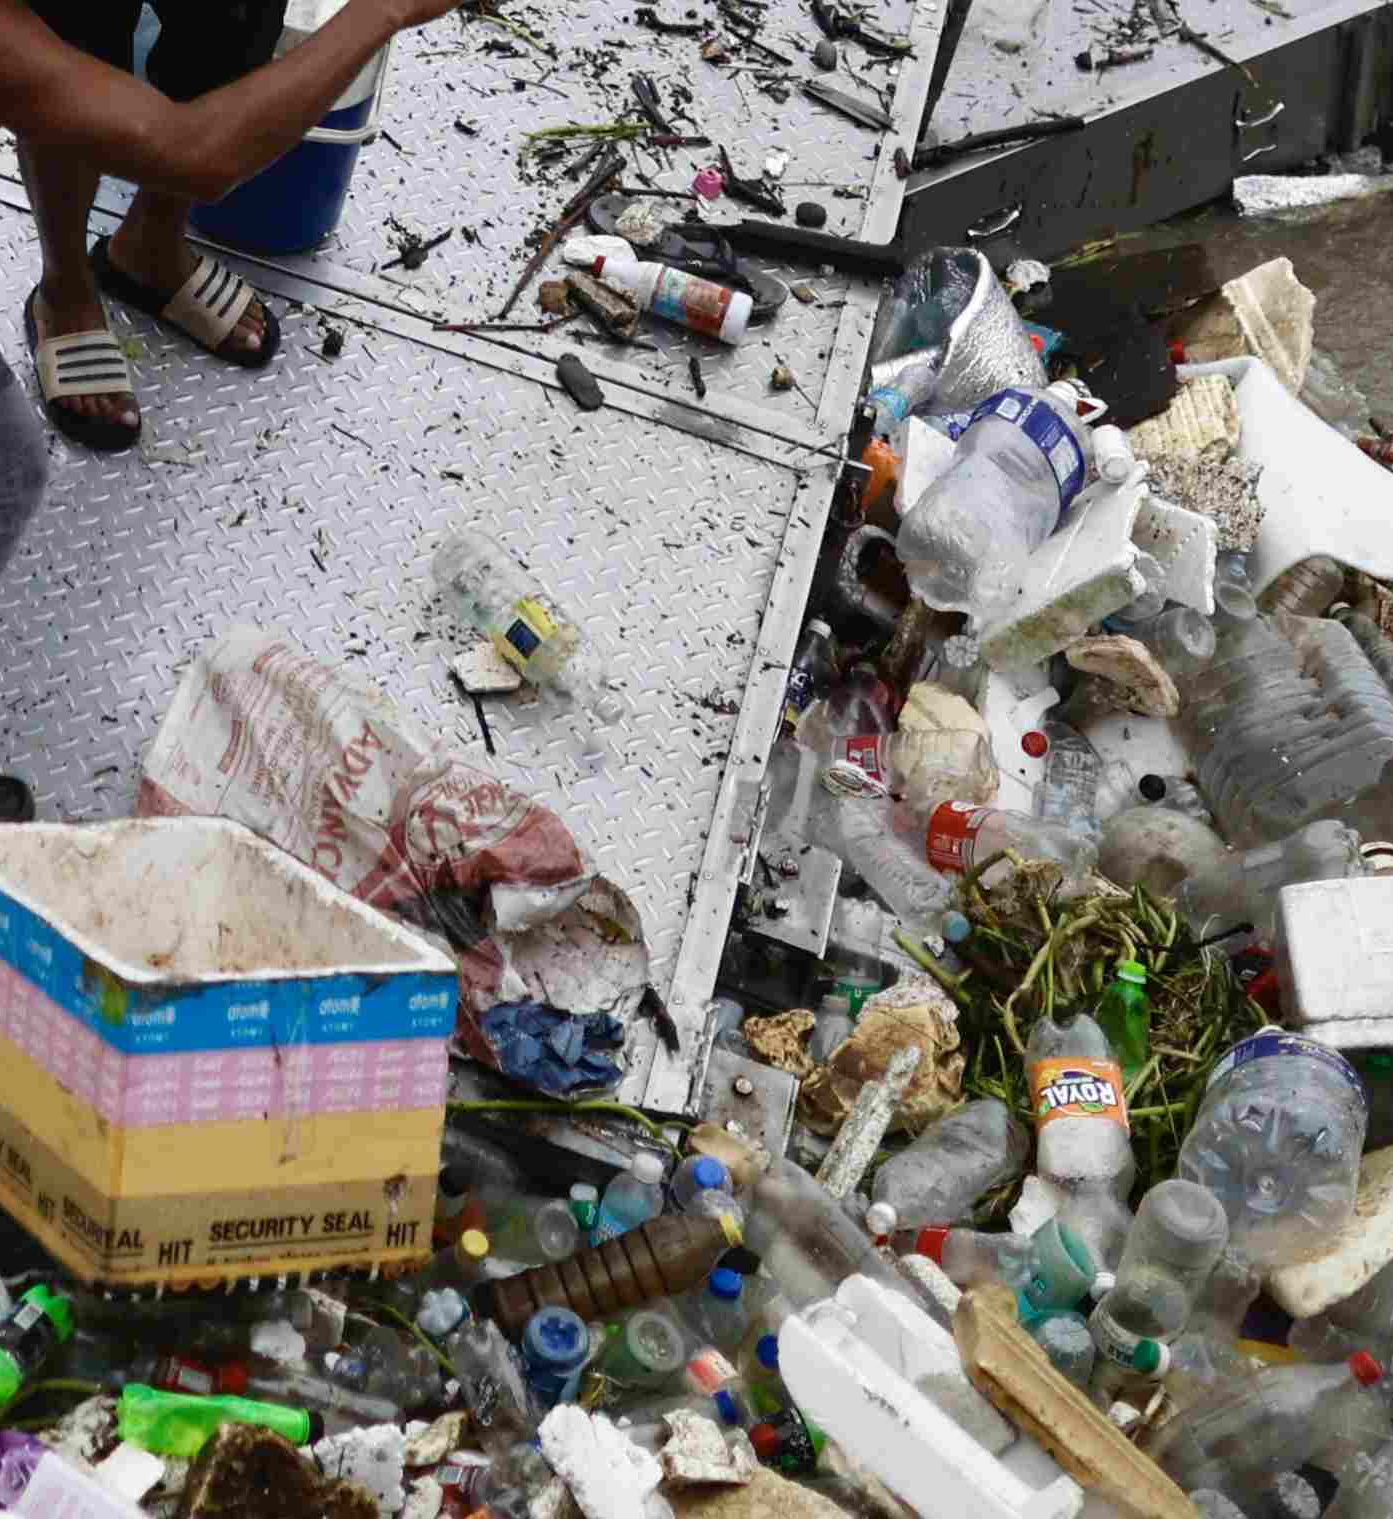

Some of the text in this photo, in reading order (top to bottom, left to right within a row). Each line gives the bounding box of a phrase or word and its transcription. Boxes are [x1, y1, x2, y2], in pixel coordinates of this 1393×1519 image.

[1041, 1082, 1118, 1108] ROYAL
[158, 1240, 194, 1266] HIT
[209, 1215, 316, 1243] SECURITY
[322, 1210, 374, 1233] SEAL
[386, 1221, 421, 1247] HIT
